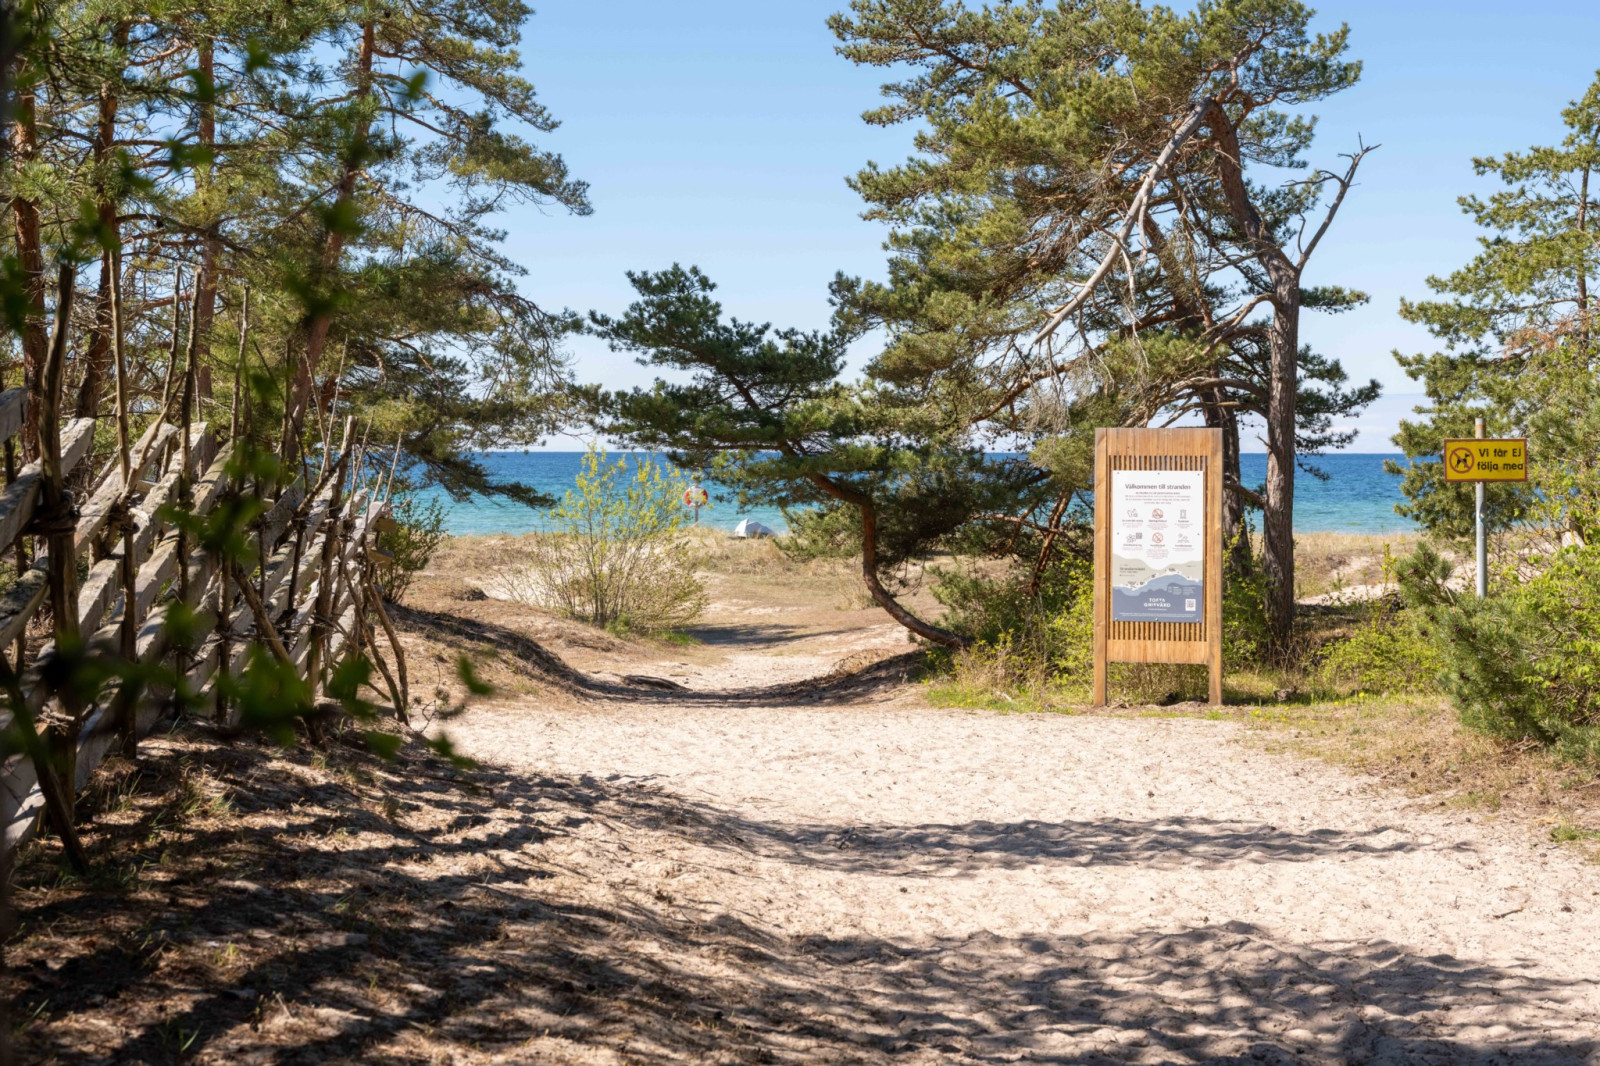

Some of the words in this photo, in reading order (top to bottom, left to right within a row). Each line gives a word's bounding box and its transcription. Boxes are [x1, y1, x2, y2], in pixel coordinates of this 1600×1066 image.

[1478, 448, 1489, 457] Vi
[1494, 448, 1508, 457] får
[1512, 448, 1522, 457] EJ
[1477, 461, 1499, 472] följa
